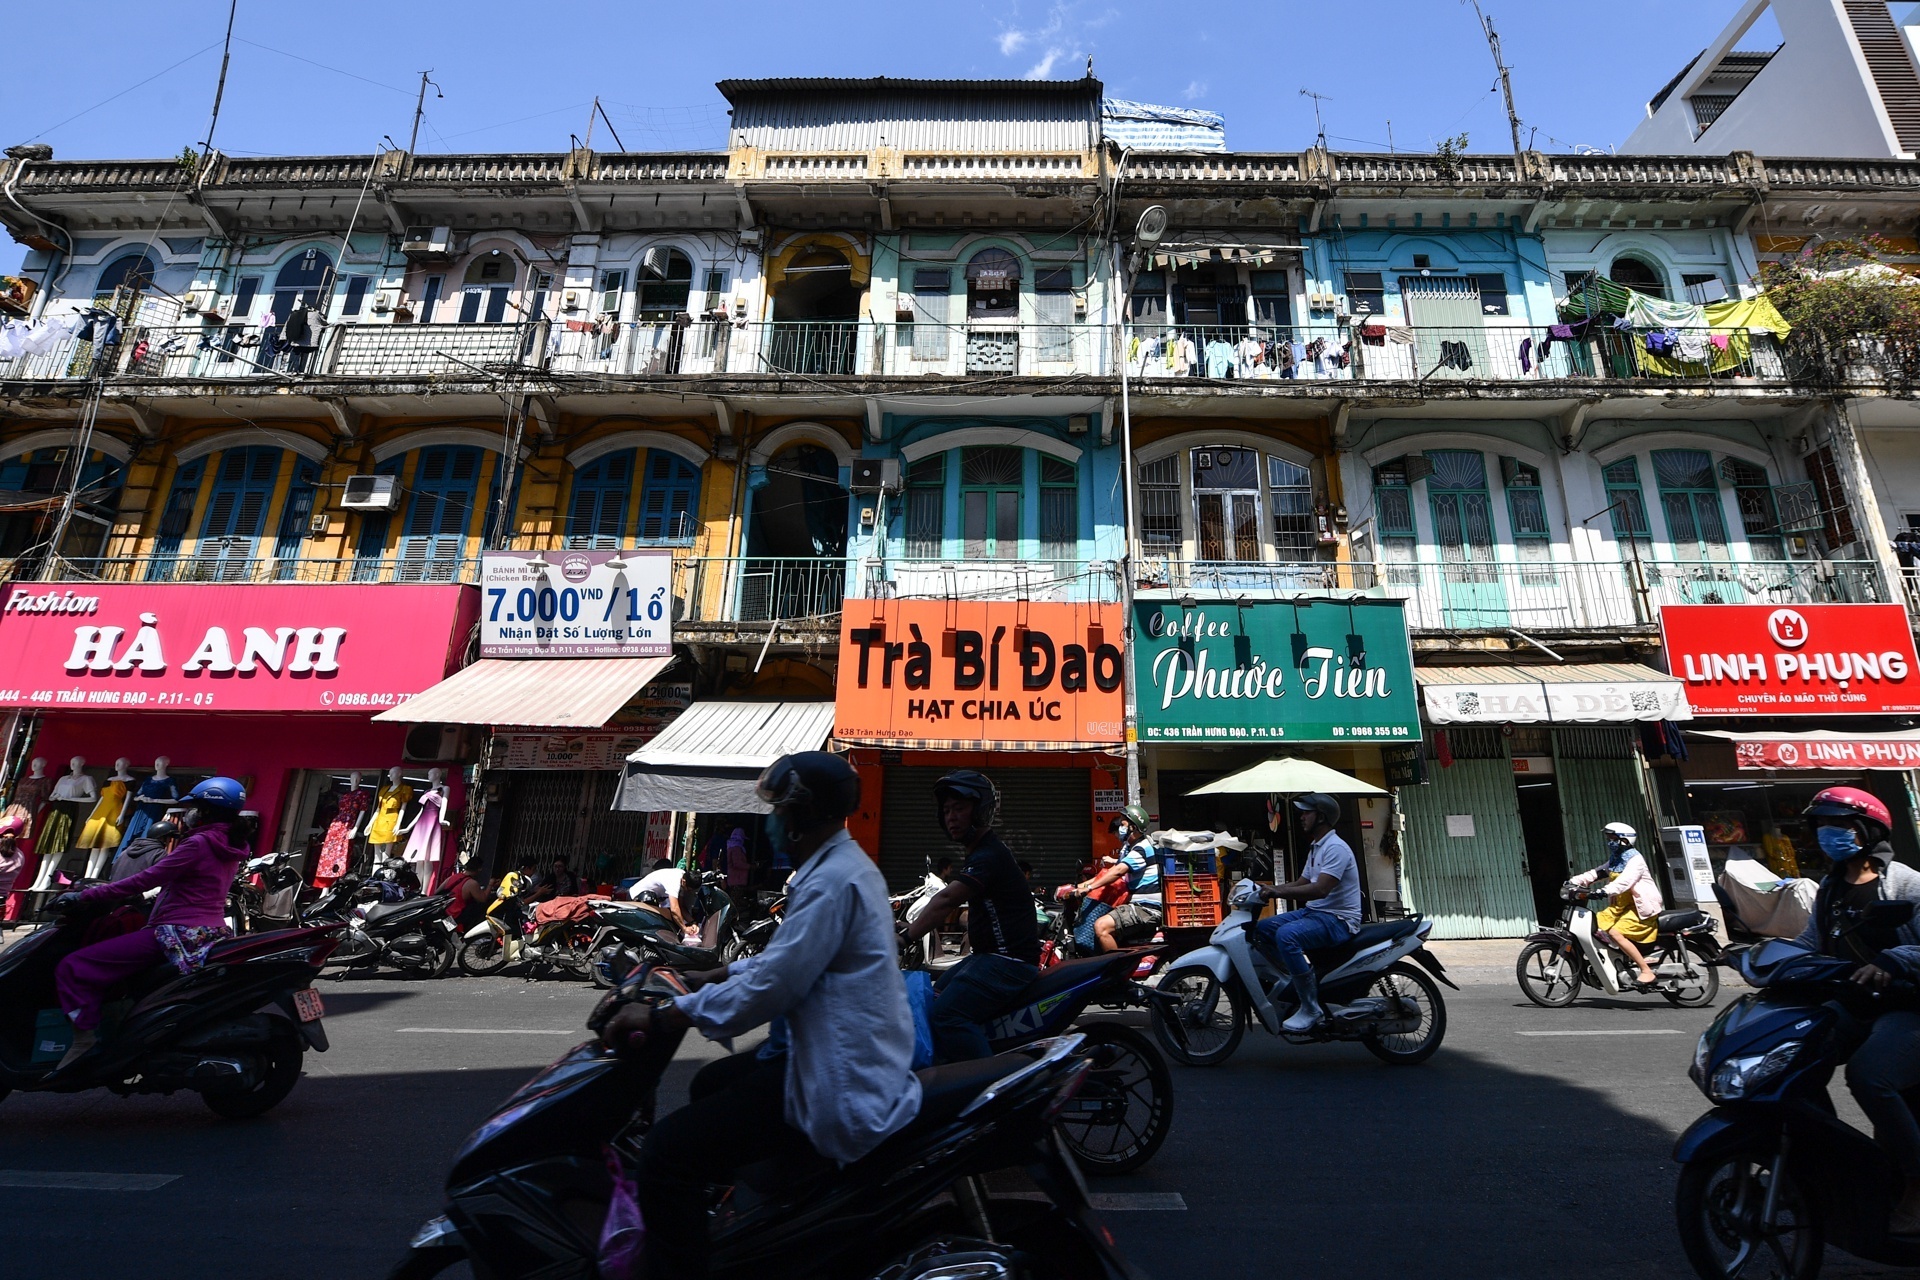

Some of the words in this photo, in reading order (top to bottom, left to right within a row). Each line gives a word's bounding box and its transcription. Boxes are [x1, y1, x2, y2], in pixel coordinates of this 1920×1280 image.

[492, 565, 515, 574] BÁNH
[517, 565, 528, 574] MÌ
[486, 575, 520, 583] (Chicken
[522, 575, 548, 583] Bread)
[4, 589, 99, 613] Fashion
[488, 587, 580, 622] 7.000
[580, 588, 603, 600] VND
[499, 626, 532, 641] Nhận
[536, 626, 559, 641] Đặt
[563, 625, 581, 638] Số
[584, 626, 624, 640] Lượng
[628, 626, 652, 638] Lớn
[1149, 611, 1231, 642] Coffee
[64, 612, 168, 671] HÀ
[181, 626, 347, 672] ANH
[484, 646, 497, 654] 442
[514, 646, 533, 655] Hưng
[534, 646, 549, 655] Đạo
[594, 646, 621, 654] Hotline:
[622, 646, 639, 654] 0938
[640, 646, 653, 654] 688
[655, 646, 668, 654] 822
[850, 623, 932, 689] Trà
[953, 625, 1006, 690] Bí
[1683, 652, 1767, 682] LINH
[1774, 651, 1909, 689] PHỤNG
[1152, 647, 1286, 711] Phước
[1299, 647, 1392, 700] Tiến
[0, 689, 20, 702] 444
[30, 690, 53, 703] 446
[88, 690, 120, 704] HƯNG
[122, 691, 147, 706] ĐẠO
[157, 692, 183, 705] P.11
[193, 693, 204, 706] Q
[205, 693, 214, 705] 5
[1480, 694, 1562, 718] HẠT
[1572, 687, 1630, 713] DẺ
[1737, 691, 1777, 703] CHUYÊN
[1778, 691, 1792, 703] ÁO
[1818, 691, 1838, 703] THỜ
[1840, 691, 1867, 703] CÚNG
[908, 699, 954, 723] HẠT
[961, 699, 1021, 721] CHIA
[1028, 697, 1062, 721] ÚC
[1687, 704, 1699, 713] 32
[838, 728, 855, 736] 438
[876, 729, 897, 738] Hưng
[898, 729, 914, 738] Đạo
[1163, 727, 1180, 737] 436
[1204, 726, 1228, 737] HƯNG
[1270, 727, 1285, 737] Q.5
[1374, 726, 1391, 736] 355
[1736, 743, 1765, 757] 432
[1805, 743, 1857, 760] LINH
